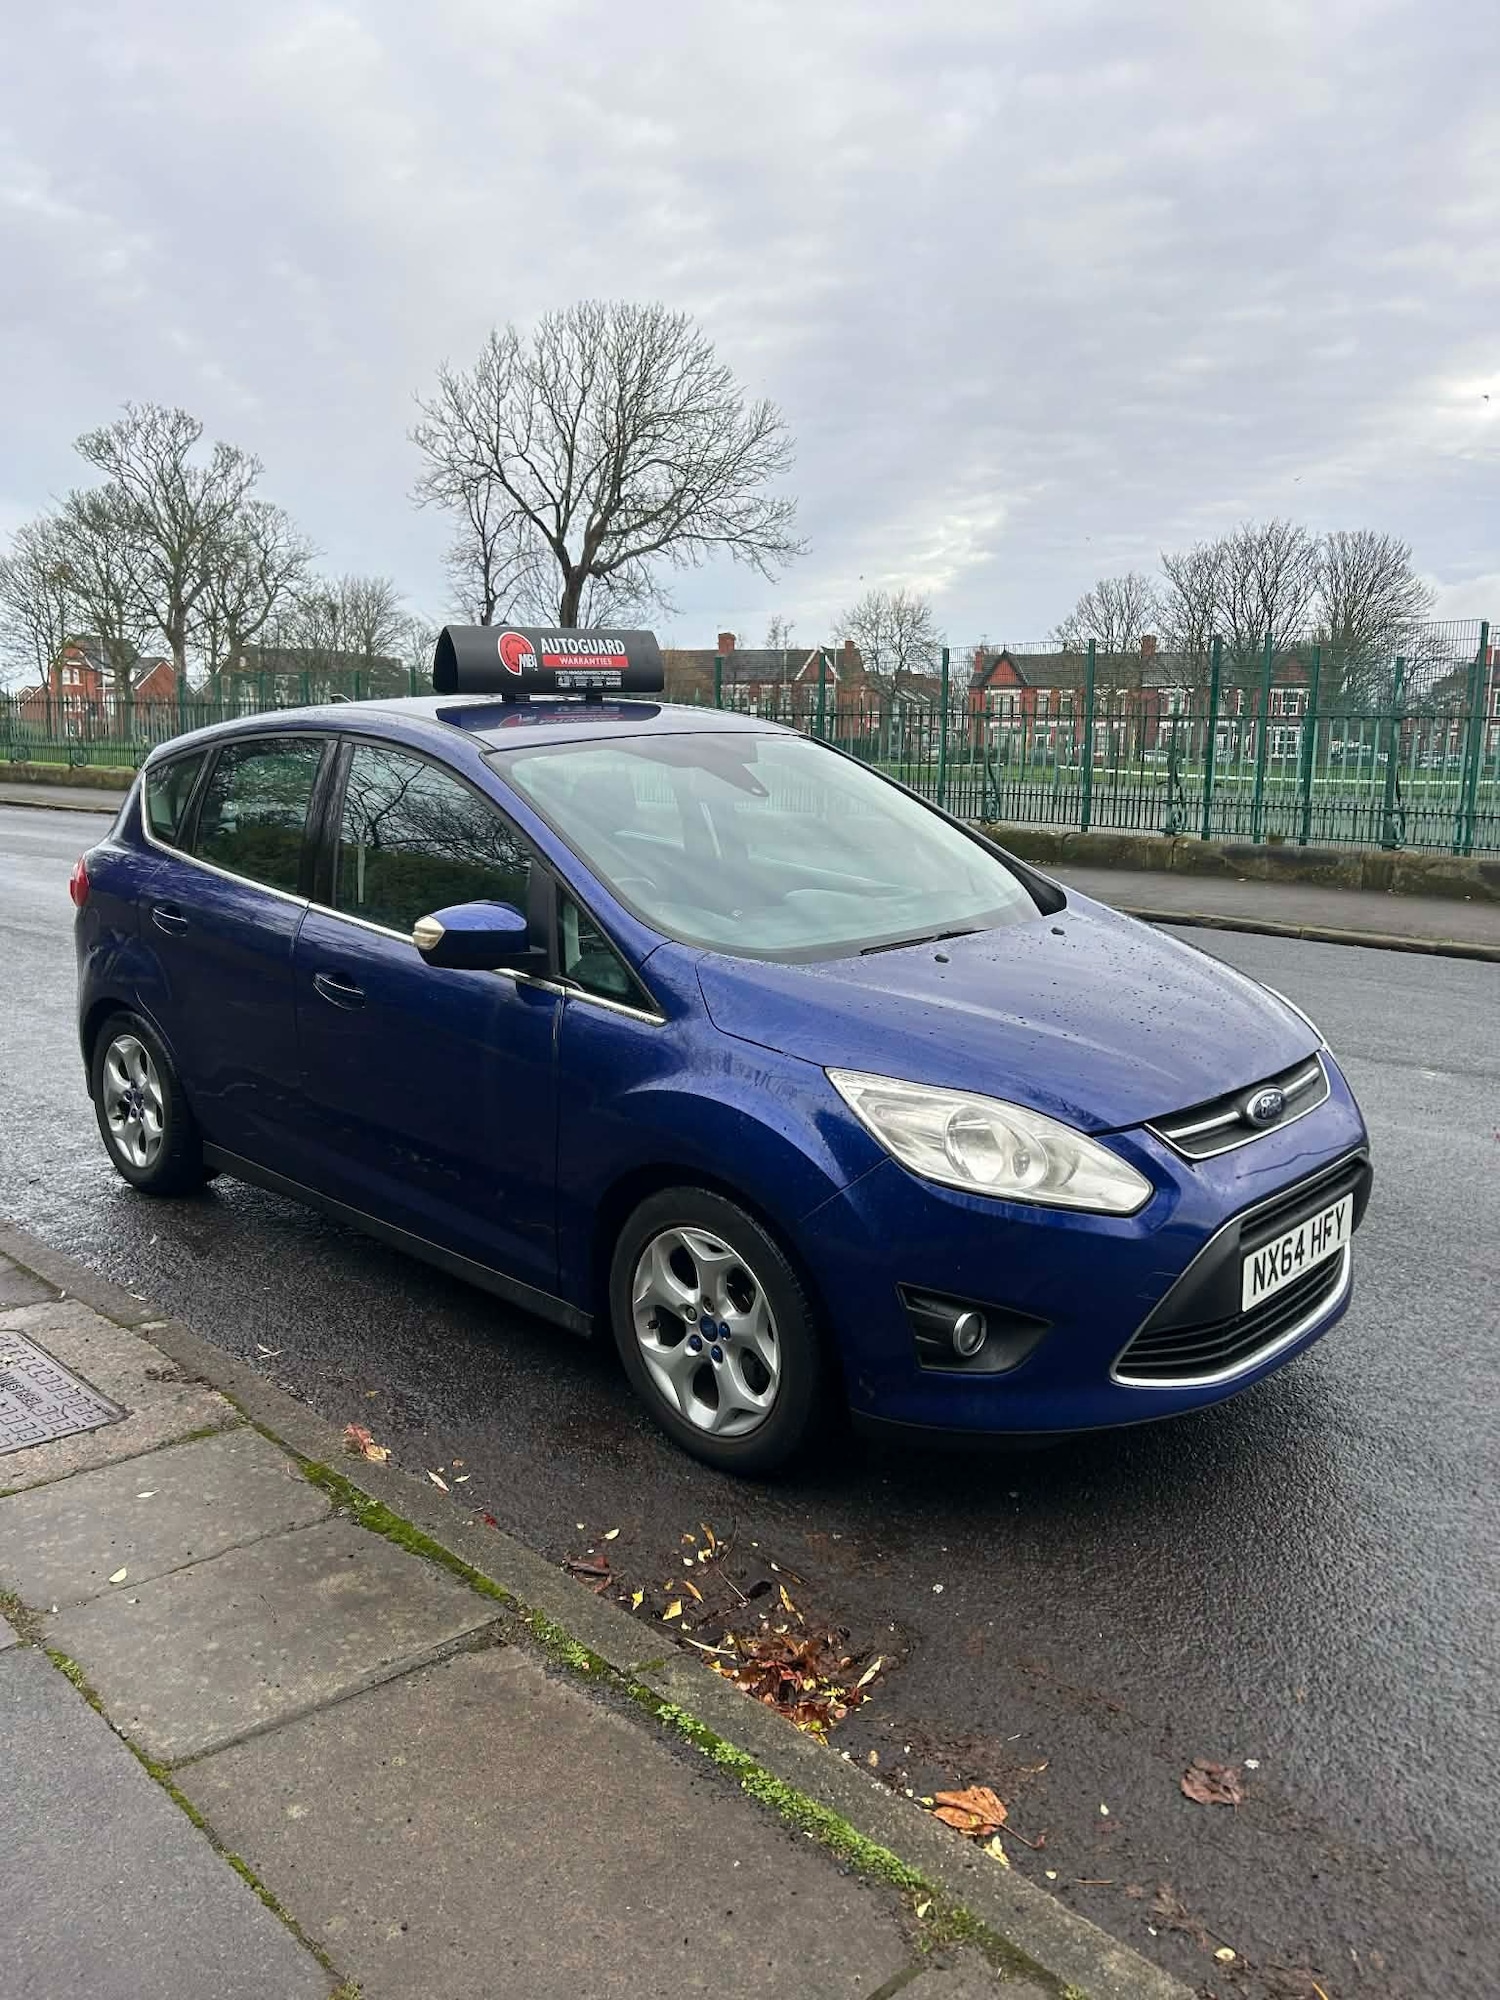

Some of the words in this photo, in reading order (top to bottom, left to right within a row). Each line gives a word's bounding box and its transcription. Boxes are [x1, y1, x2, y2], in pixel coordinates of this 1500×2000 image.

[541, 638, 625, 655] AUTOGUARD
[560, 657, 612, 665] WARRANTIES
[1253, 1229, 1304, 1296] NX64
[1311, 1203, 1345, 1258] HFY
